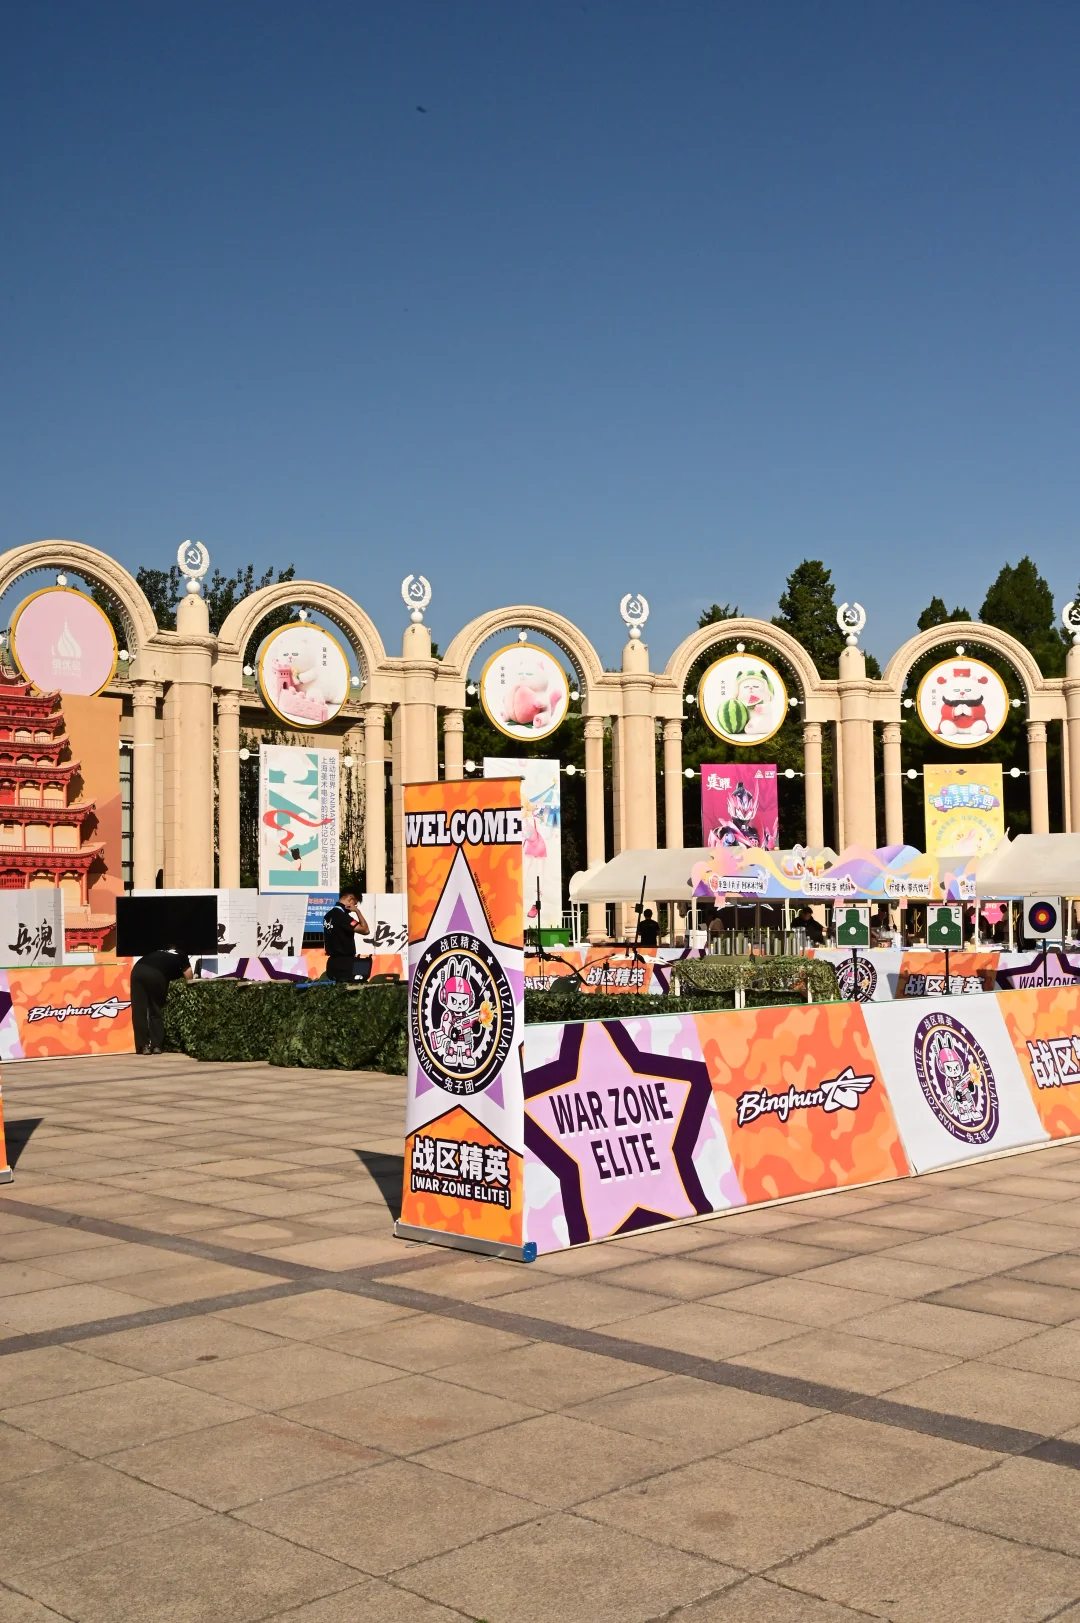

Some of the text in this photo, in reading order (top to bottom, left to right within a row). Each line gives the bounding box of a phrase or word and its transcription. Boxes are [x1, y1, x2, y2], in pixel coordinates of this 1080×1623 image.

[405, 810, 522, 845] WELCOME
[954, 908, 960, 919] 2
[440, 935, 481, 953] 战区精英
[585, 966, 647, 987] 战区精英
[1019, 976, 1044, 989] WAR
[28, 1005, 93, 1023] Binghun
[411, 969, 433, 1074] WAR ZONE ELITE
[496, 974, 514, 1062] TUZITUAN
[923, 1014, 954, 1028] 战区精英
[444, 1077, 475, 1094] 兔子团
[973, 1040, 998, 1109] TUZITUAN
[914, 1047, 956, 1134] WAR ZONE ELITE
[549, 1082, 674, 1135] WAR ZONE
[737, 1086, 825, 1127] Binghun
[966, 1129, 990, 1144] 兔子团
[412, 1136, 509, 1186] 战区精英
[590, 1132, 661, 1180] ELITE
[441, 1180, 475, 1198] ZONE
